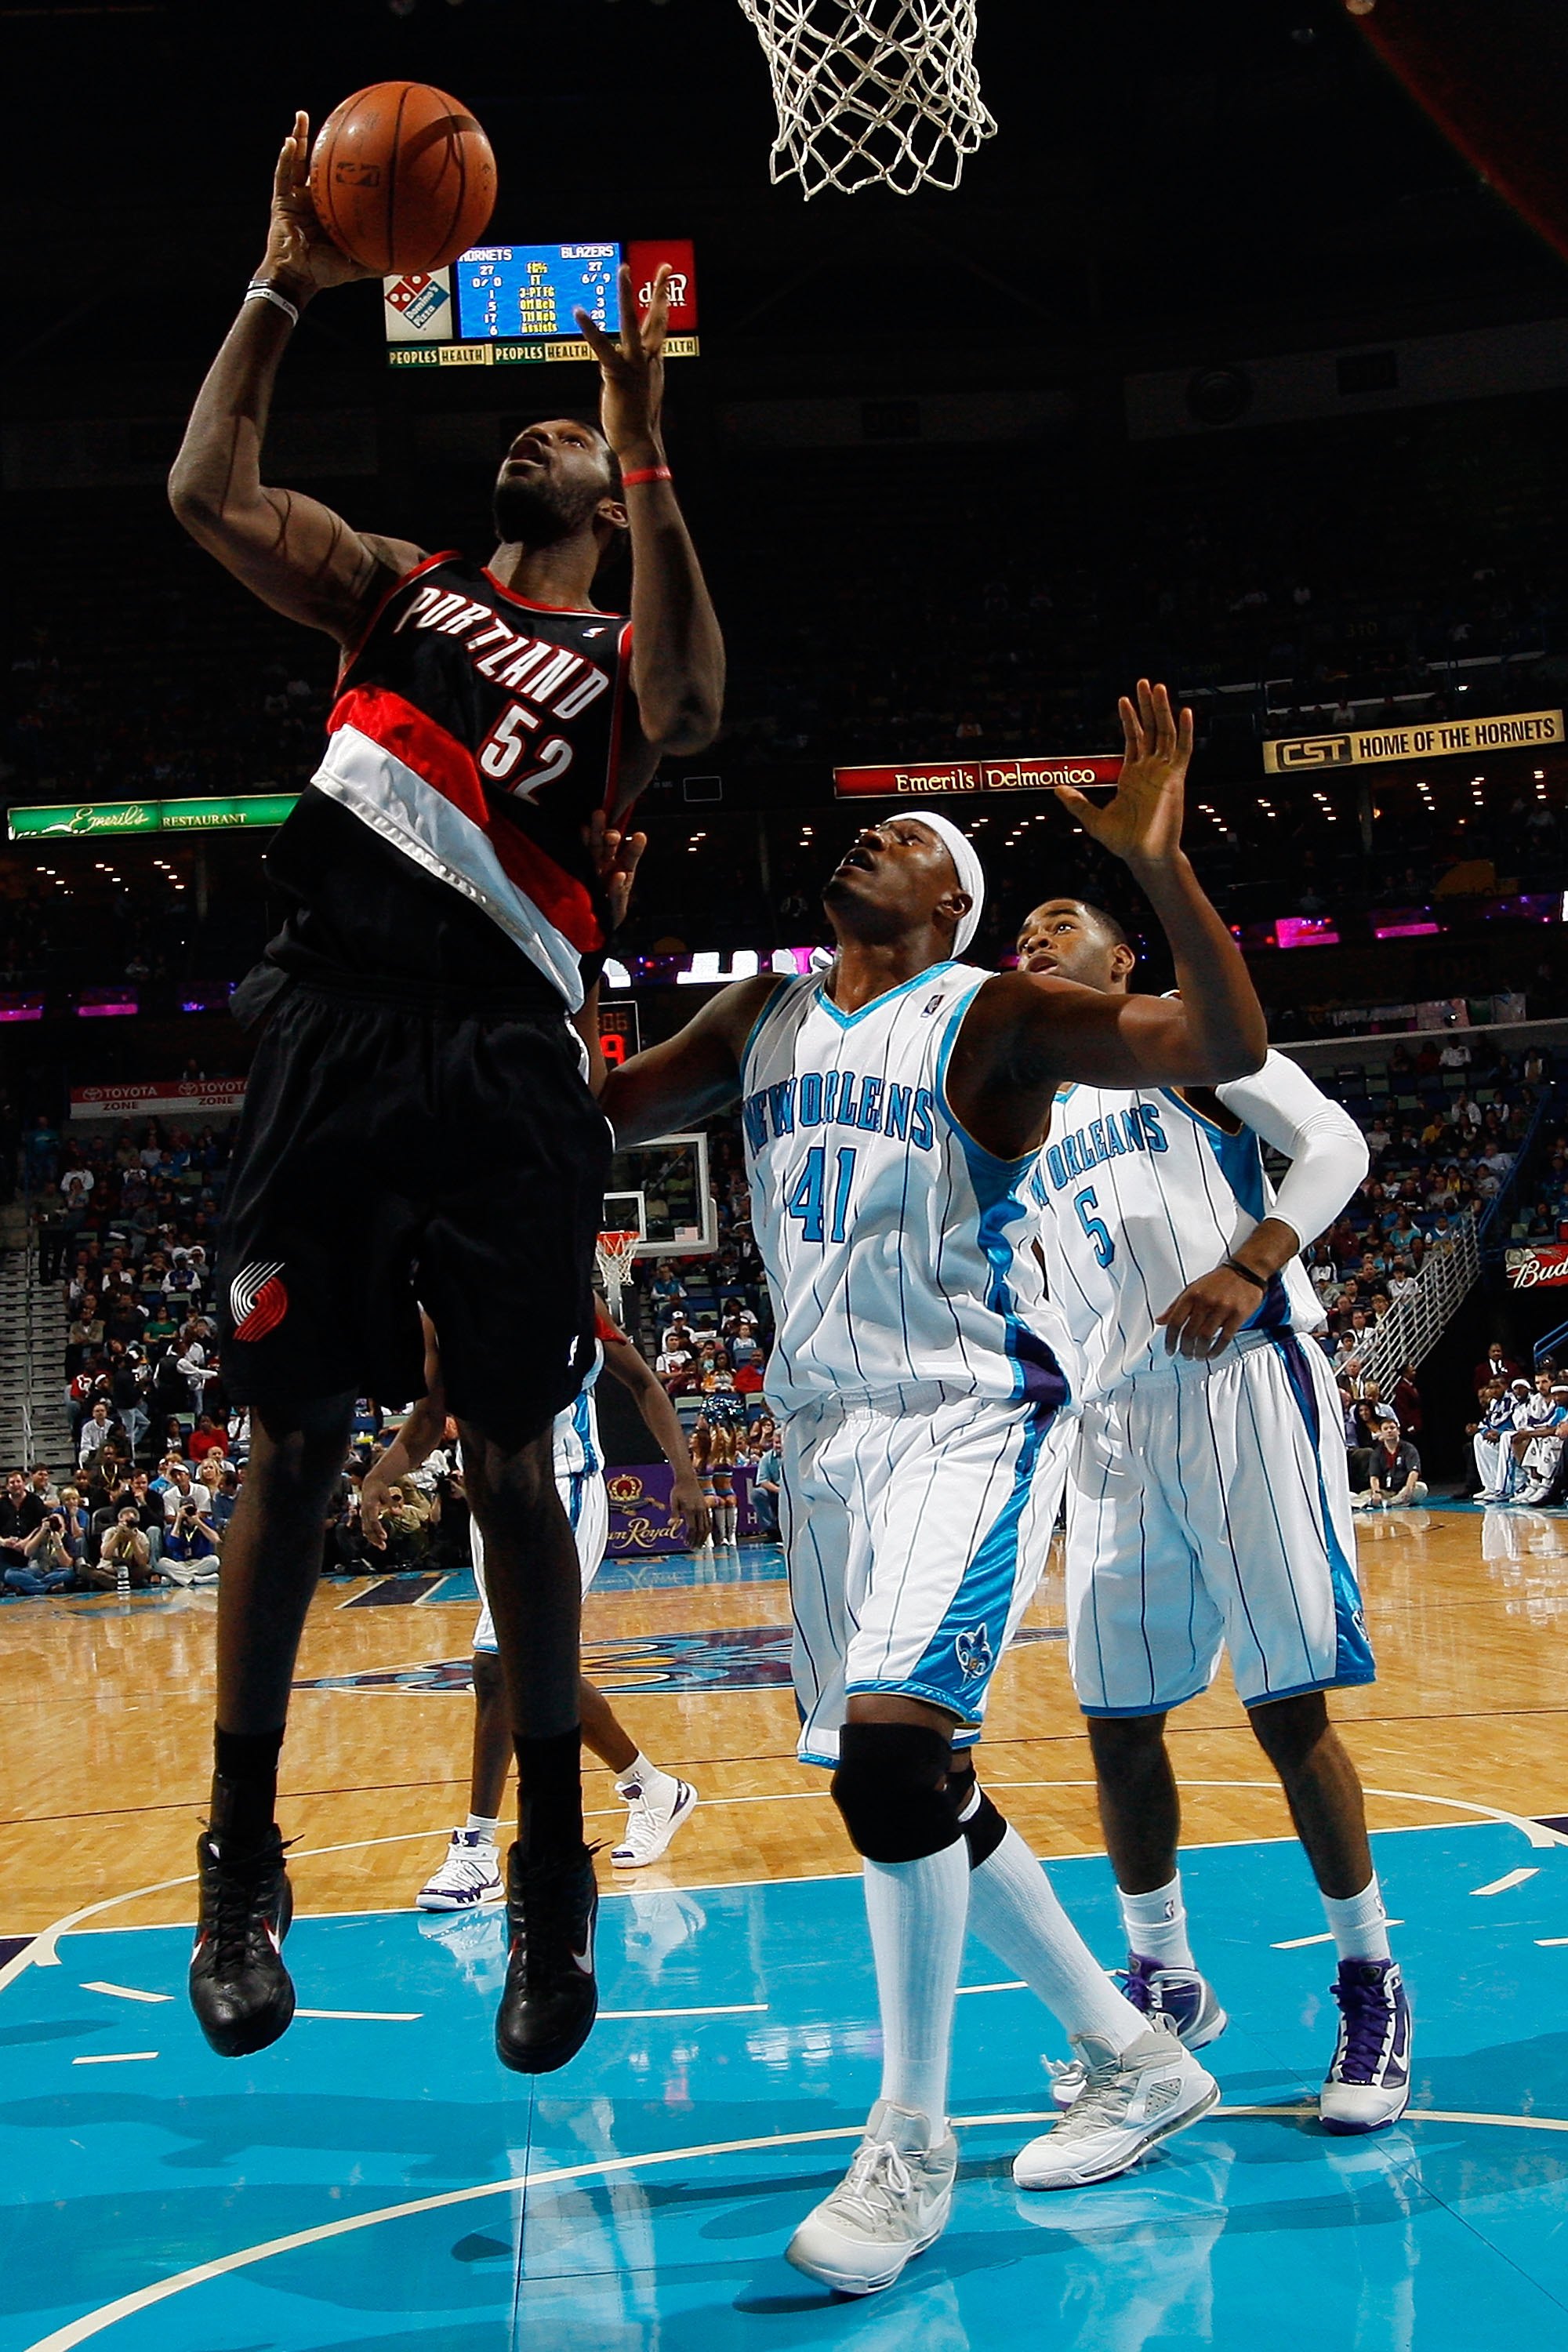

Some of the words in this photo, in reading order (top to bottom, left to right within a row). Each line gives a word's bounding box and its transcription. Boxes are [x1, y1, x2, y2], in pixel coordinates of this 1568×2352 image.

[561, 245, 614, 259] BLAZERS
[480, 265, 494, 276] 27
[588, 261, 602, 272] 27
[489, 289, 494, 299] 1
[596, 285, 604, 296] 0
[406, 285, 438, 319] Domino's
[488, 301, 497, 312] 5
[597, 297, 605, 308] 3
[485, 313, 496, 324] 17
[591, 309, 605, 320] 20
[489, 325, 498, 336] 6
[389, 350, 437, 365] PEOPLES
[441, 349, 482, 362] HEALTH
[495, 347, 543, 361] PEOPLES
[549, 344, 588, 358] HEALTH
[393, 586, 610, 721] PORTLAND
[1283, 739, 1346, 766] CST
[1359, 735, 1409, 758] HOME
[1414, 731, 1436, 753] OF
[1439, 727, 1471, 749] THE
[1475, 717, 1555, 745] HORNETS
[479, 703, 574, 807] 52
[895, 769, 975, 792] Emeril's
[986, 763, 1095, 787] Delmonico
[69, 805, 149, 833] Emeril's
[163, 813, 247, 827] RESTAURANT
[104, 1087, 157, 1098] TOYOTA
[103, 1102, 139, 1111] ZONE
[198, 1097, 234, 1105] ZONE
[1046, 1104, 1169, 1191] ORLEANS
[789, 1146, 857, 1243] 41
[1073, 1185, 1115, 1269] 5
[612, 1518, 684, 1549] Royal
